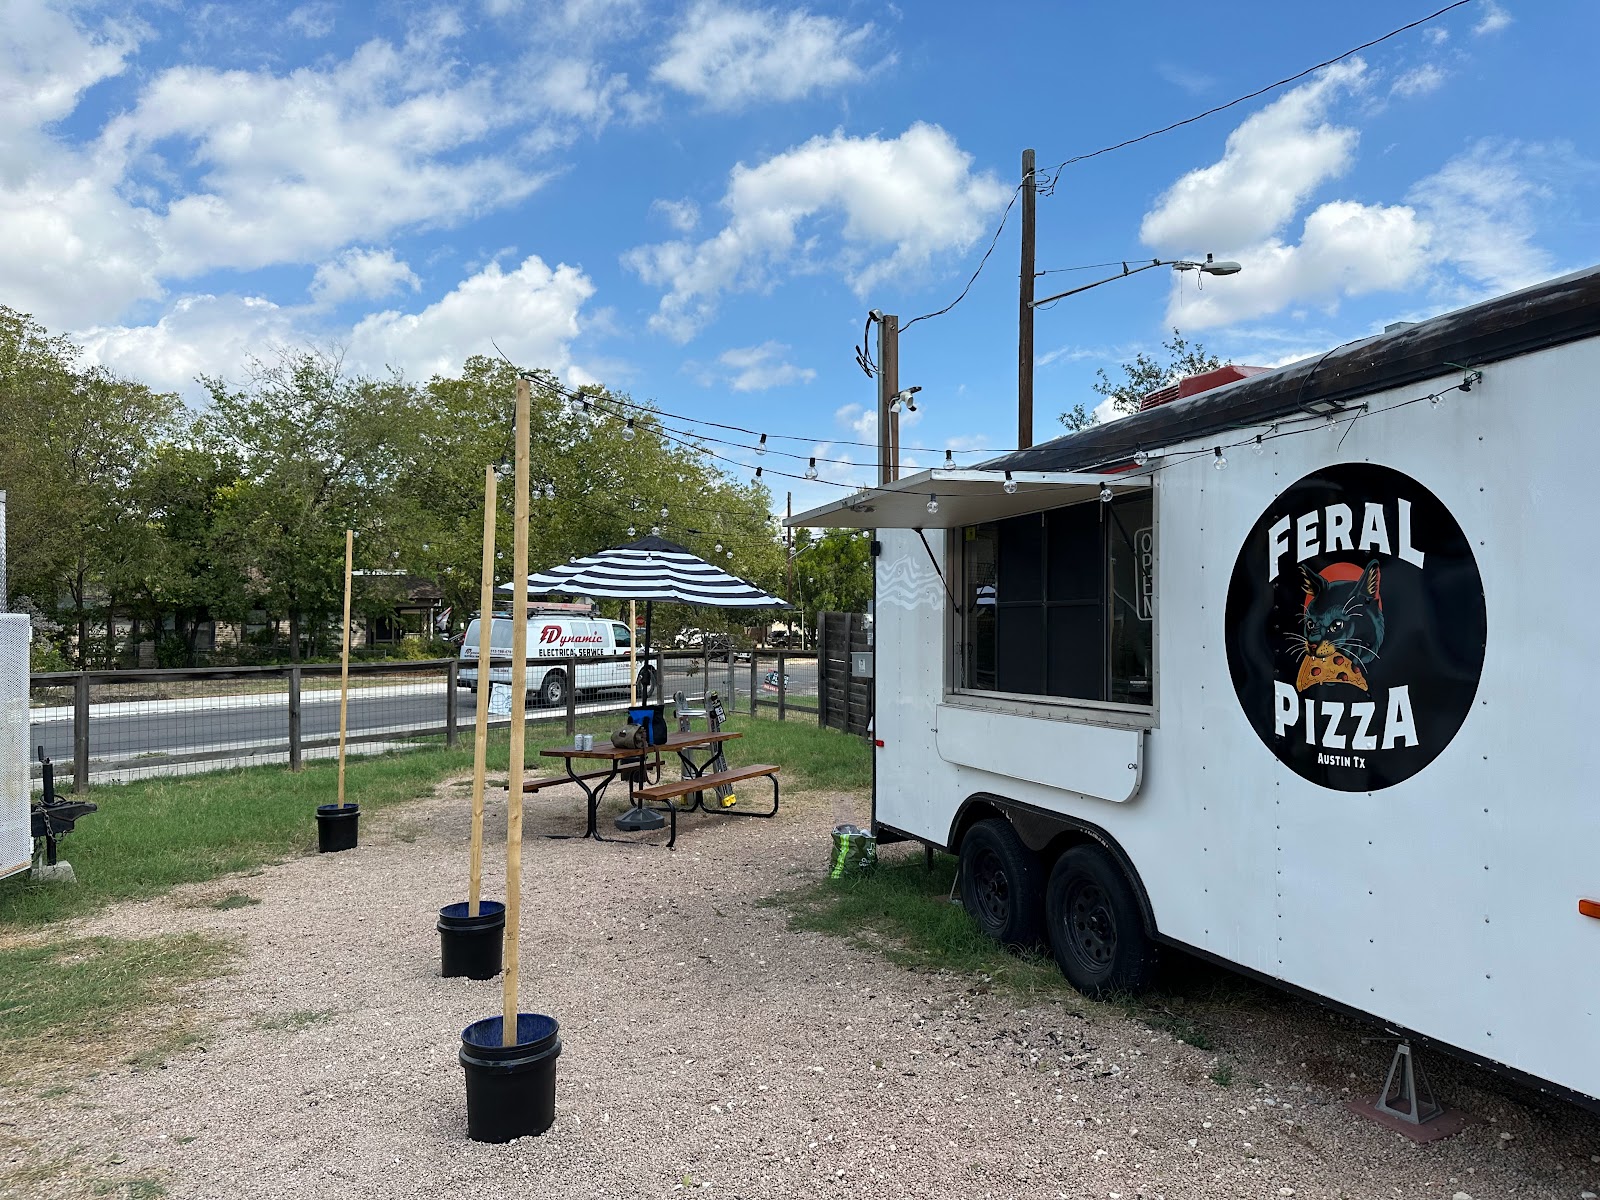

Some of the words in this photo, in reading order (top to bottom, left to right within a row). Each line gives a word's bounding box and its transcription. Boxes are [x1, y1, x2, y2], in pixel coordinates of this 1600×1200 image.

[1268, 498, 1425, 583] FERAL
[1141, 533, 1153, 617] OPEN
[539, 625, 603, 647] Dynamic
[579, 648, 604, 657] SERVICE
[1274, 680, 1419, 750] PIZZA
[1318, 753, 1350, 767] AUSTIN
[1353, 756, 1366, 768] TX
